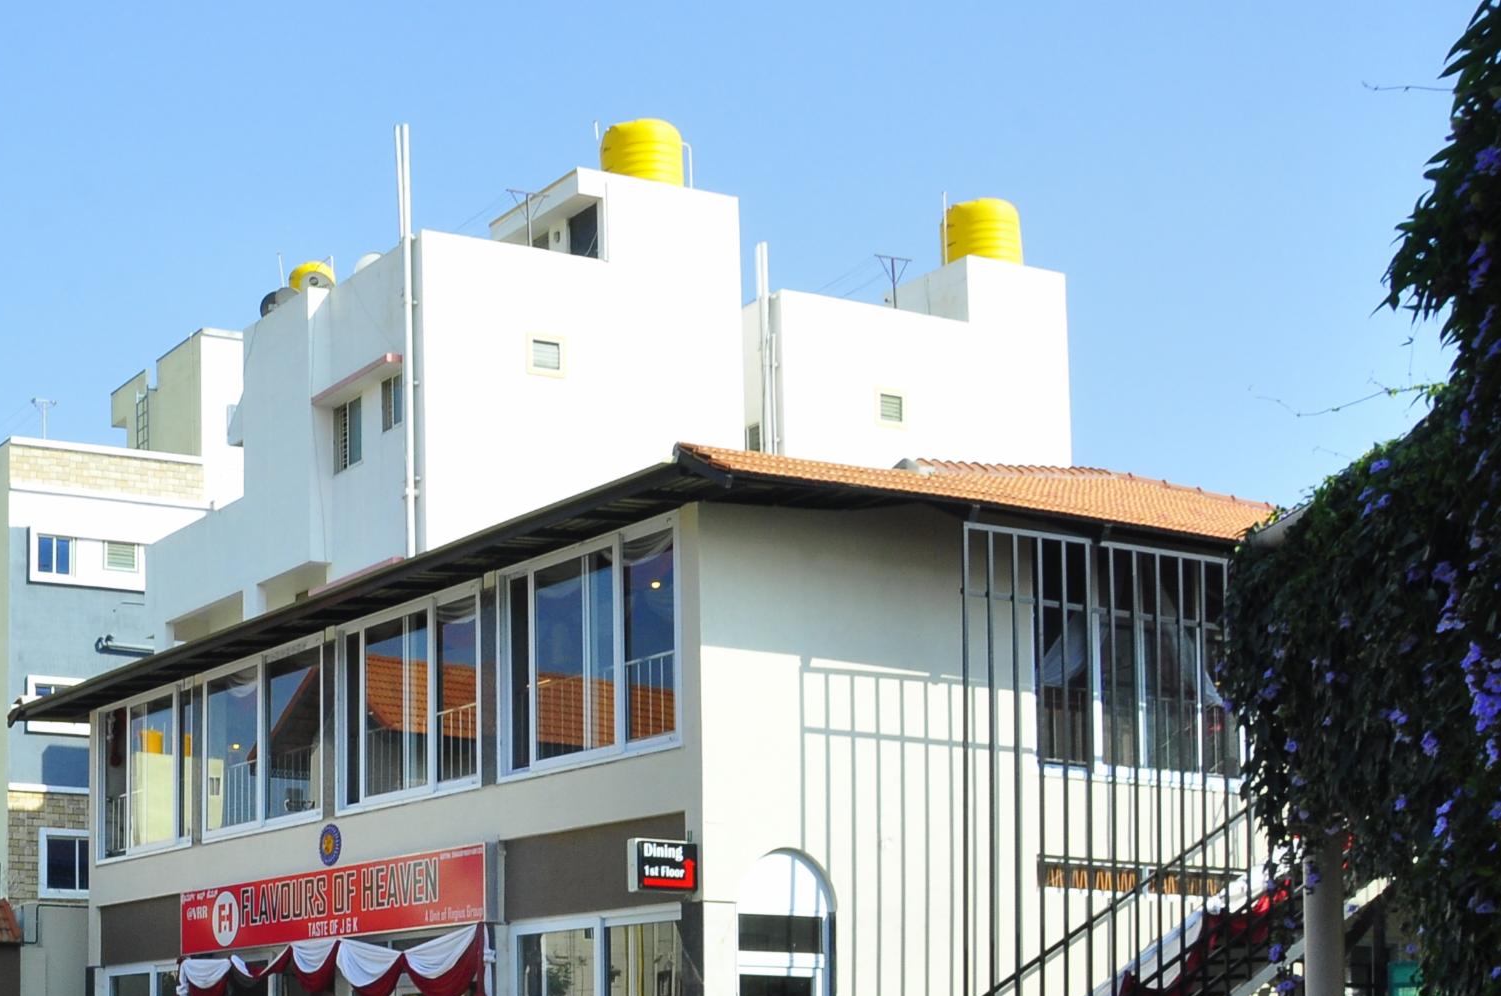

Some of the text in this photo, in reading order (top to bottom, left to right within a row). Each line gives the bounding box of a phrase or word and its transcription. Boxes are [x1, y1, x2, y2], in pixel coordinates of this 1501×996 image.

[643, 842, 684, 862] Dining
[643, 864, 685, 878] 1st Floor
[241, 857, 439, 927] FLAVOURS OF HEAVEN
[308, 917, 358, 937] TASTE OF J & K
